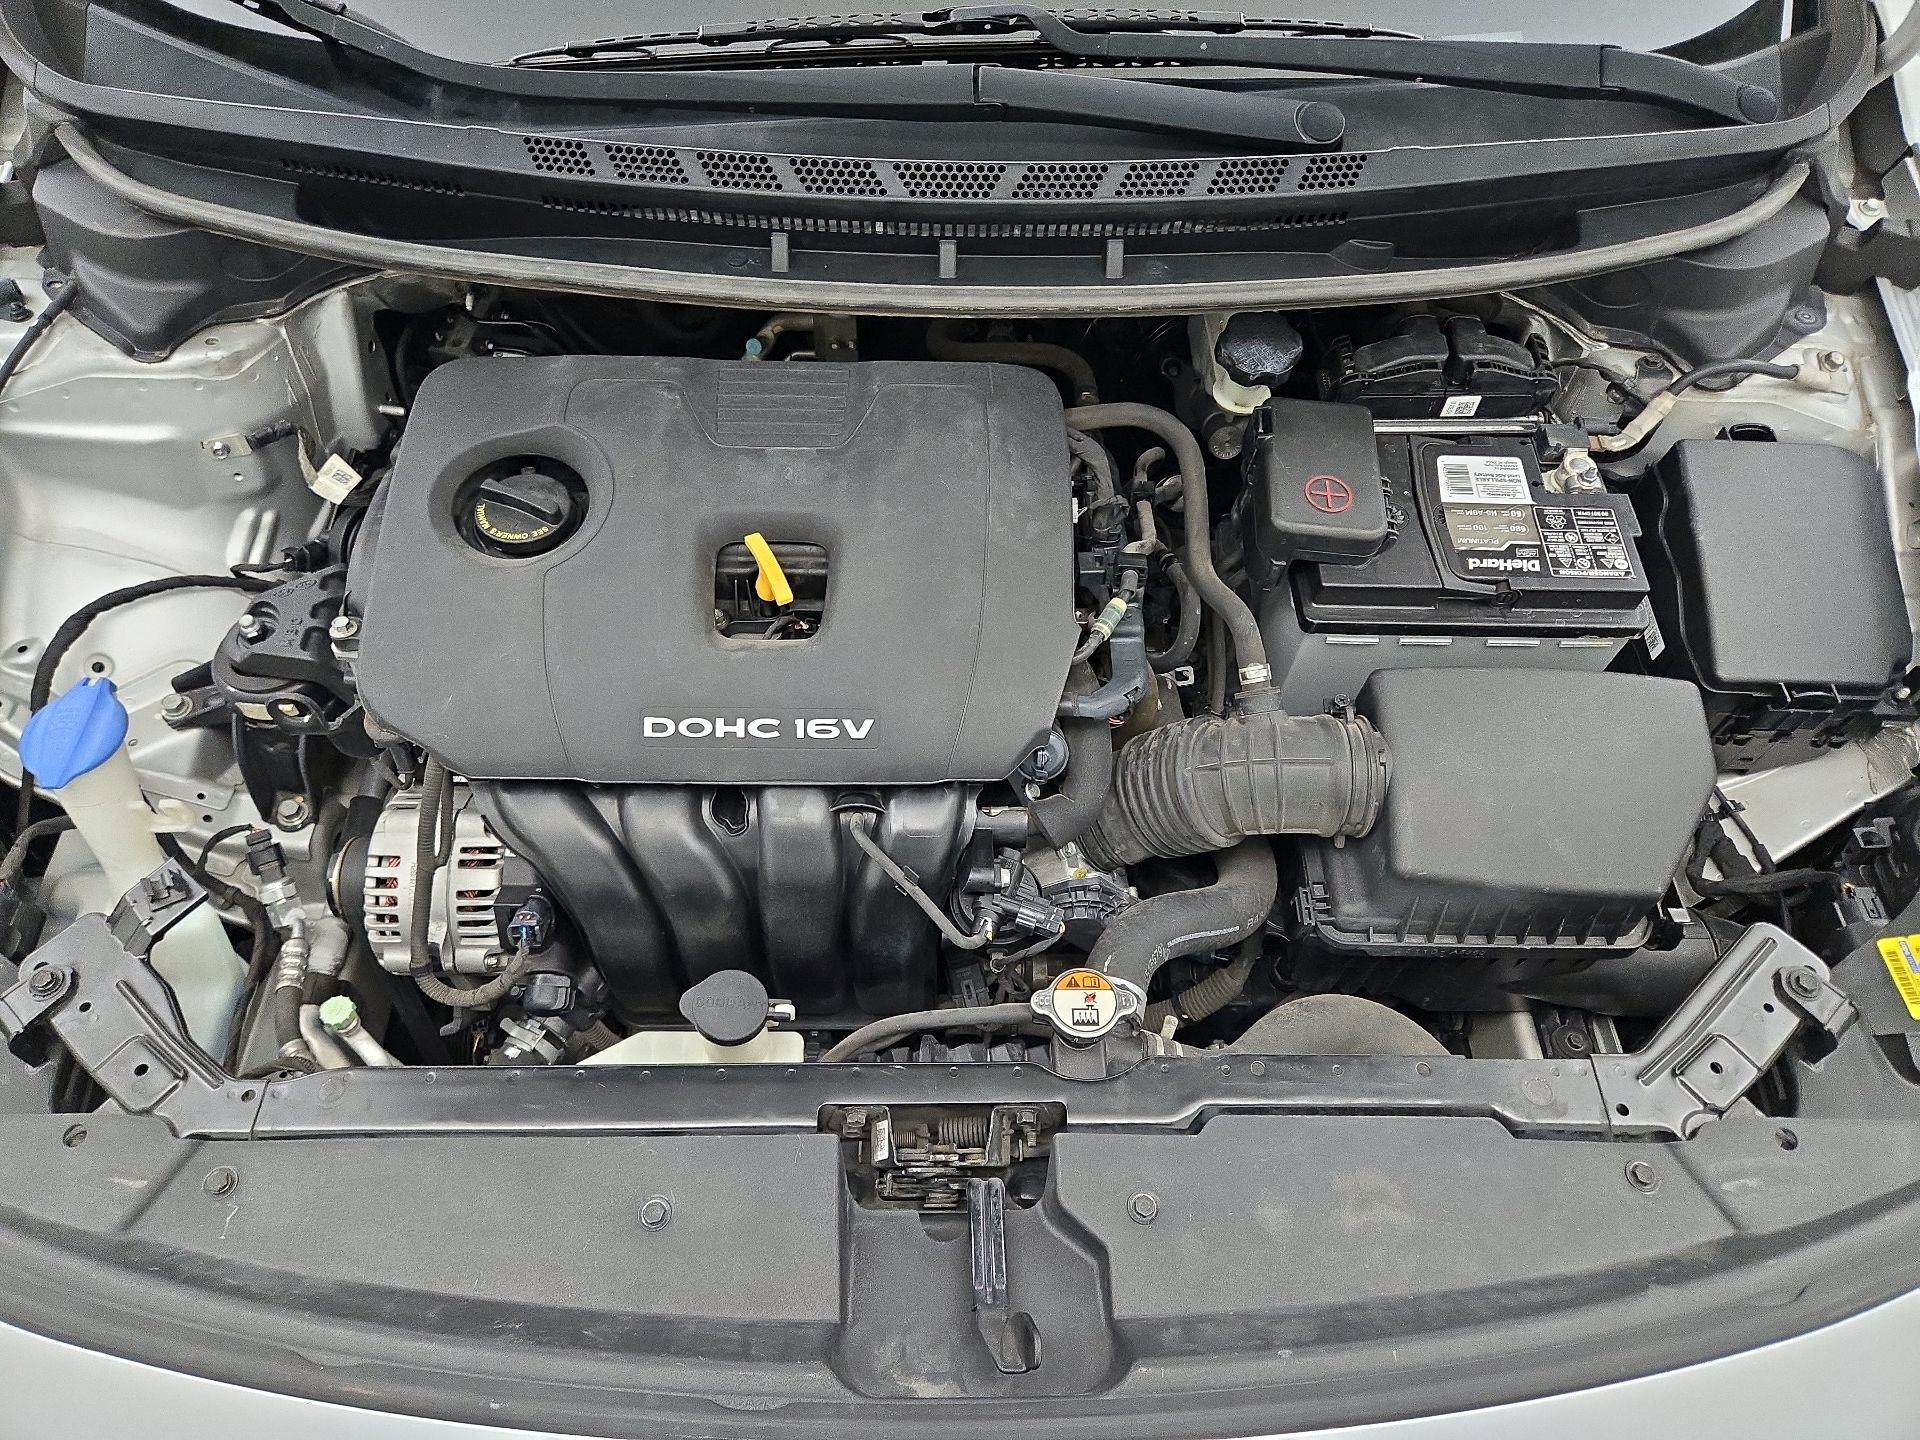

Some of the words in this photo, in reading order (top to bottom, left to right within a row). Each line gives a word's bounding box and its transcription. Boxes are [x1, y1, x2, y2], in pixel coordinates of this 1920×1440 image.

[476, 503, 492, 530] MANUAL
[1510, 510, 1522, 518] 60
[491, 527, 529, 540] OWNER'S
[531, 526, 549, 538] SEE
[1509, 525, 1527, 533] 680
[1457, 537, 1500, 545] PLATINUM
[1468, 557, 1541, 571] DieHard
[643, 716, 781, 739] DOHC
[794, 718, 876, 740] 16V
